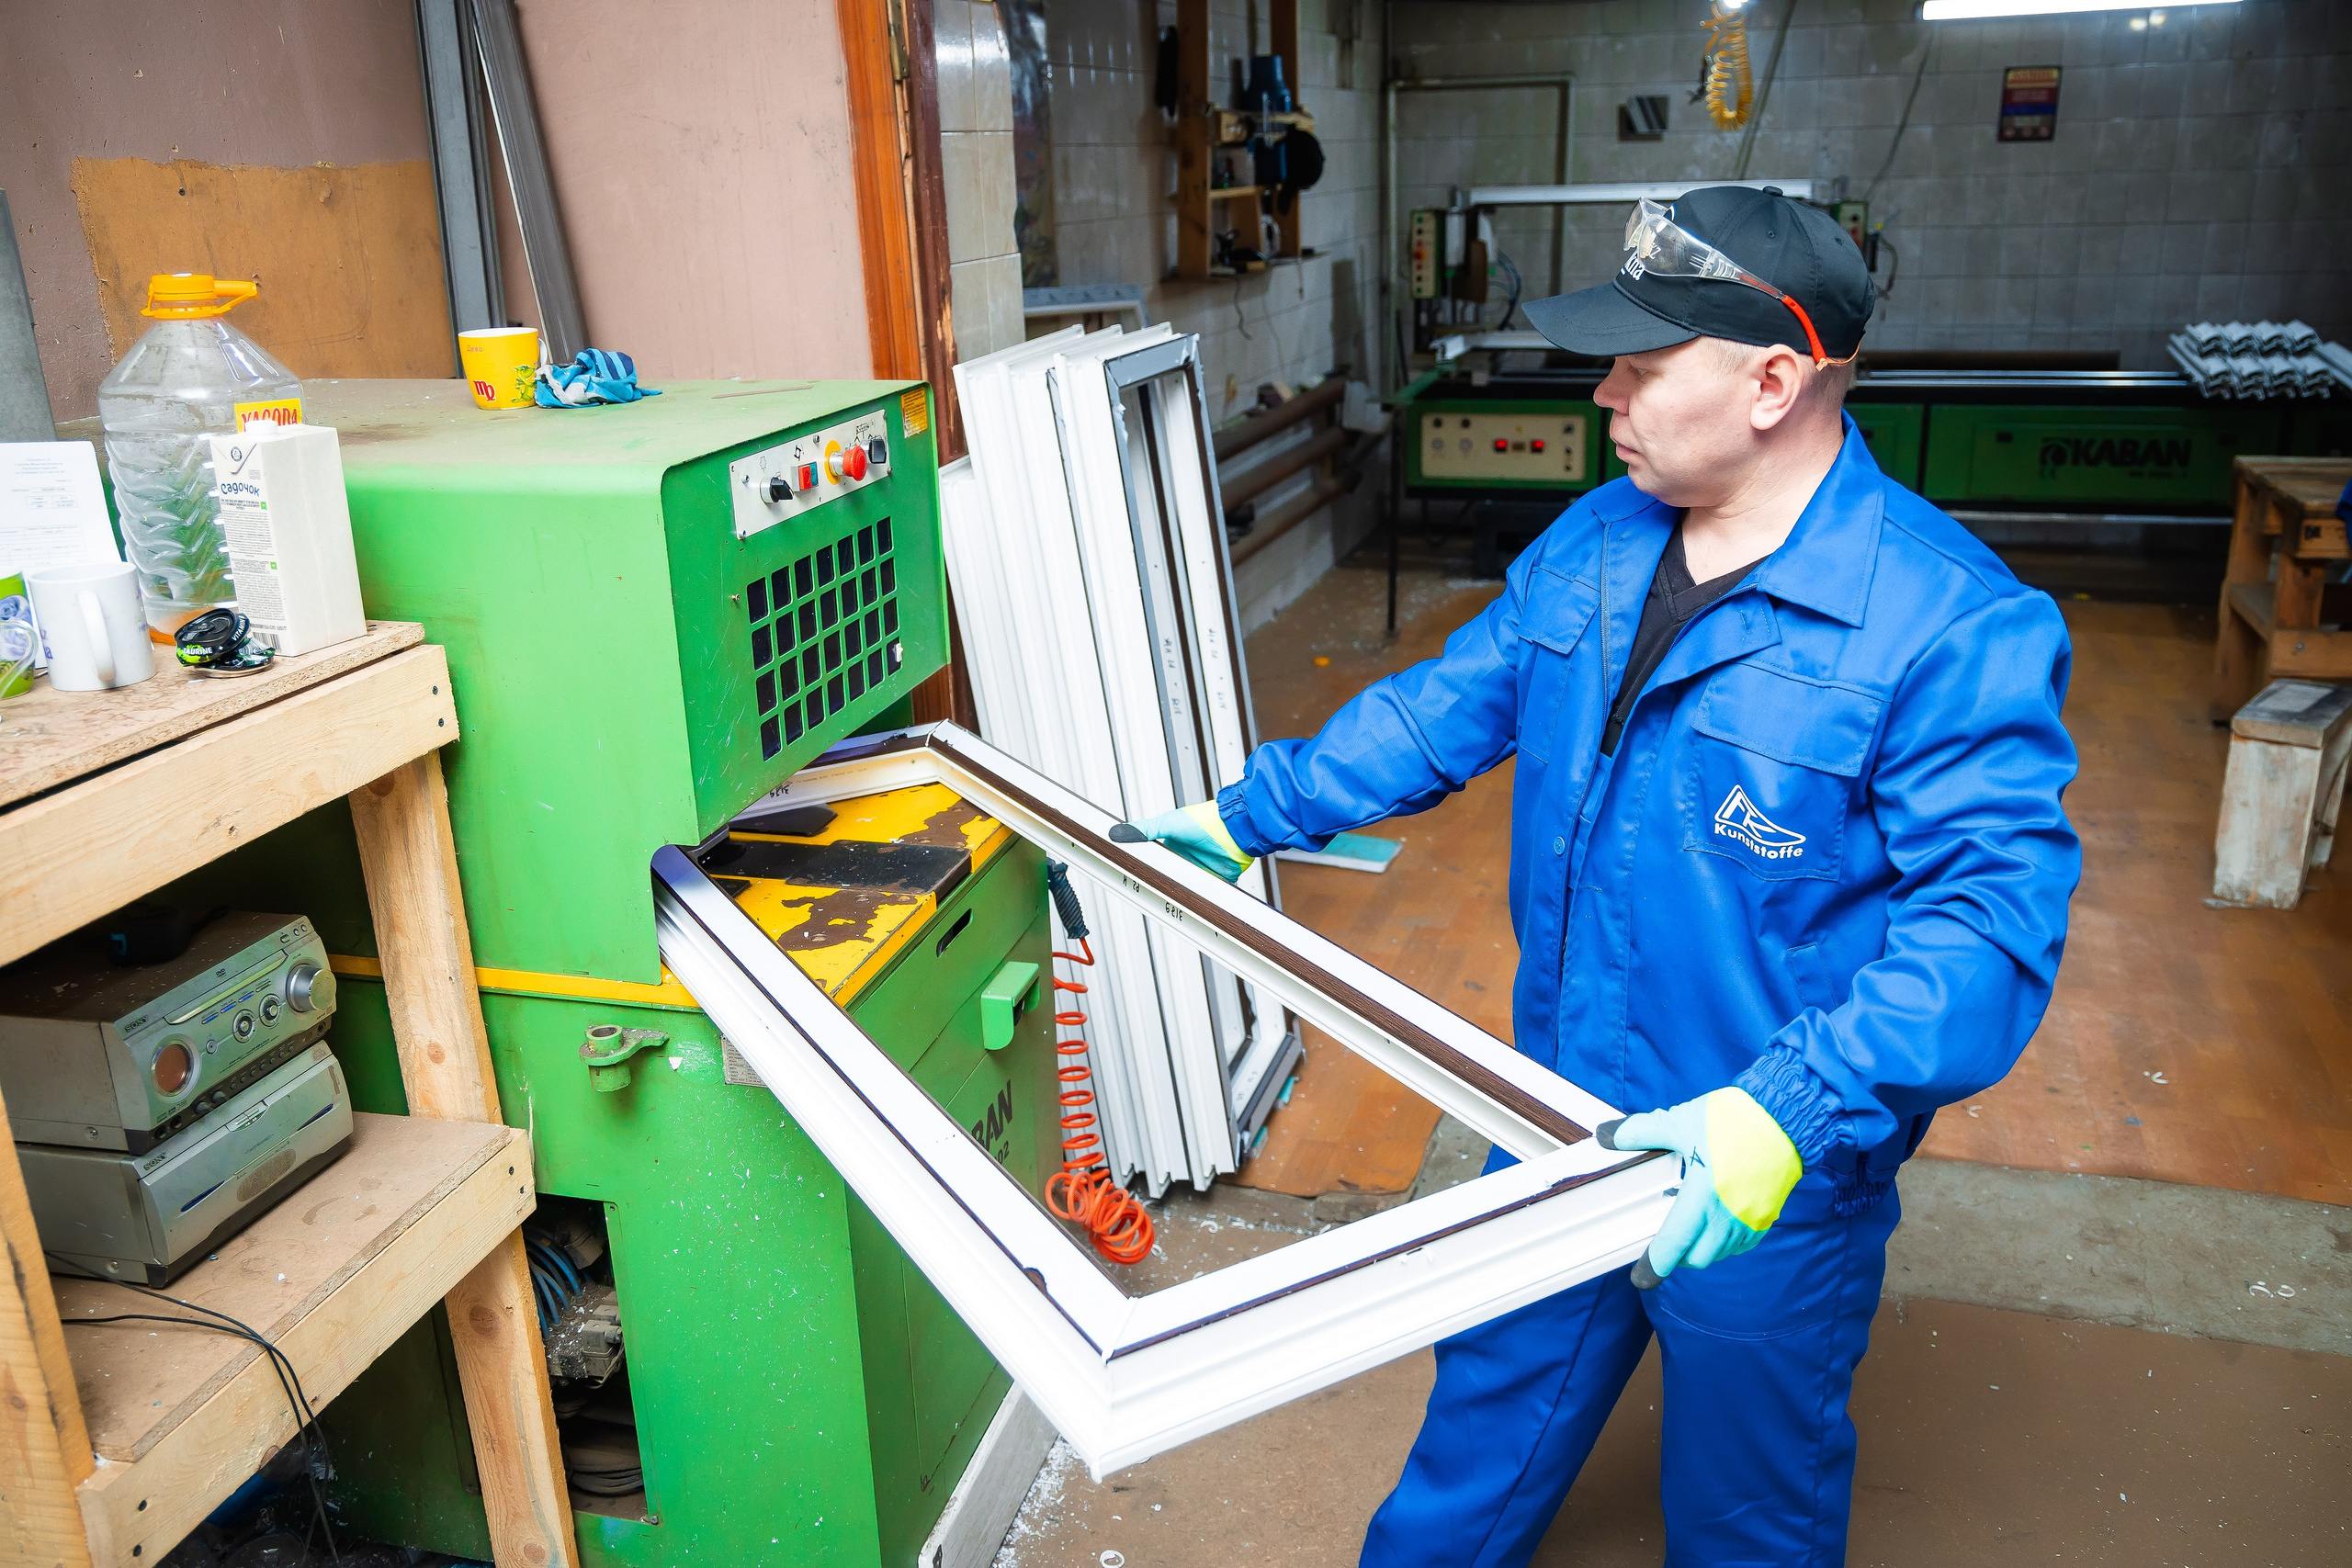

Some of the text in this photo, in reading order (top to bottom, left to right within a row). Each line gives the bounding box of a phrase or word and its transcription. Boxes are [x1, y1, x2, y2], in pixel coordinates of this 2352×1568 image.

[2071, 437, 2193, 468] KABAN
[220, 481, 260, 497] Садочок
[183, 646, 213, 656] TAURINE
[1713, 822, 1804, 860] Kunststoffe
[124, 1014, 150, 1033] SONY
[143, 1151, 168, 1171] SONY
